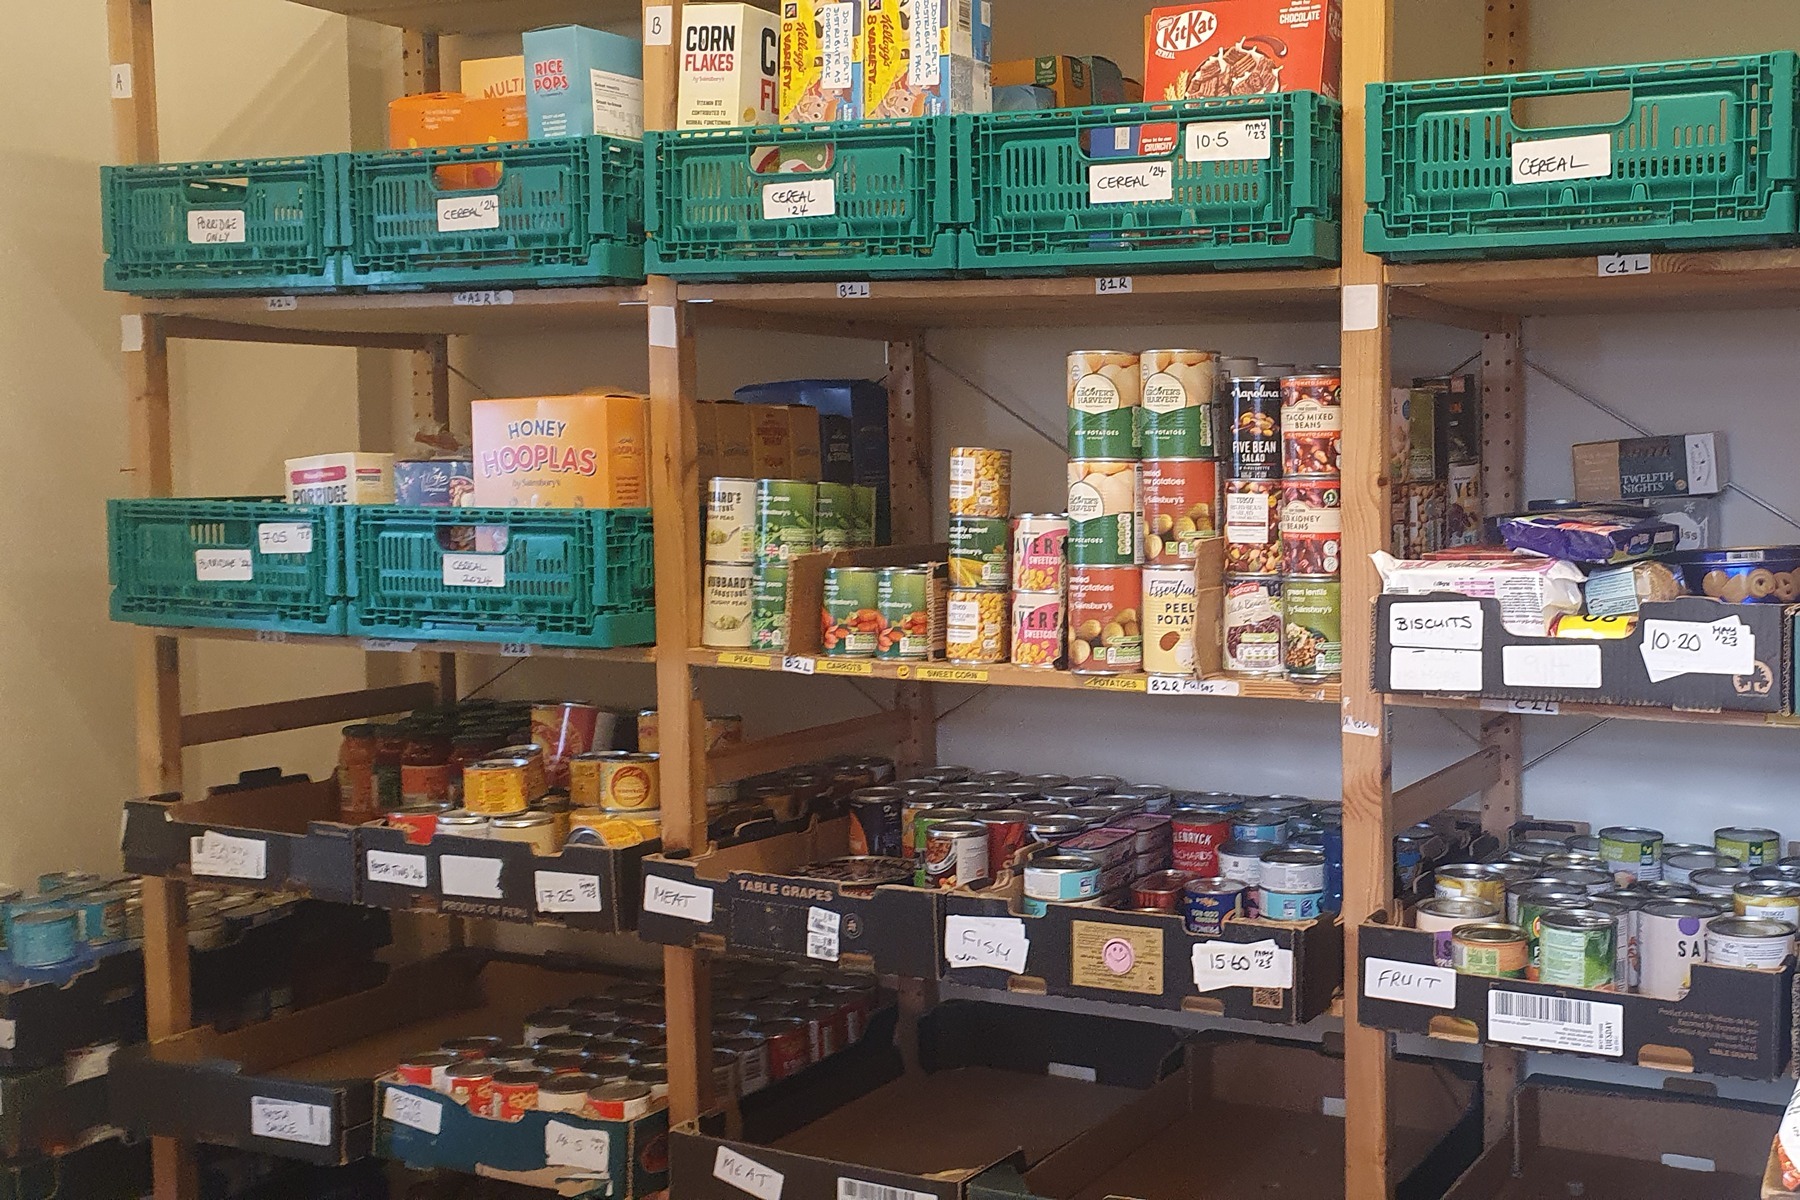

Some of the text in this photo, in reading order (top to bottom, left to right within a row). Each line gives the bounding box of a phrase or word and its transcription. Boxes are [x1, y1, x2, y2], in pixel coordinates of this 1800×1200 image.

[651, 16, 662, 34] B
[1279, 10, 1320, 24] CHOCOLATE
[686, 25, 735, 52] CORN
[1163, 12, 1215, 50] KitKat
[685, 54, 734, 72] FLAKES
[783, 34, 792, 90] VARIETY
[868, 26, 877, 84] VARIETY
[534, 60, 564, 76] RICE
[114, 74, 122, 90] A
[533, 75, 569, 94] POPS
[1144, 142, 1174, 153] CRUNCHY
[1519, 154, 1590, 177] CEREAL
[1097, 174, 1150, 190] CEREAL
[770, 190, 816, 204] CEREAL
[508, 420, 567, 440] HONEY
[1252, 441, 1276, 454] BEAN
[482, 446, 598, 478] HOOPLAS
[1242, 454, 1266, 462] SALAD
[1152, 478, 1186, 487] potatoes
[1622, 472, 1674, 484] TWELFTH
[1622, 482, 1665, 494] NIGHTS
[1148, 496, 1185, 506] Sainsbury's
[1080, 584, 1114, 592] potatoes
[1074, 602, 1114, 612] Sainsbury's
[1165, 603, 1195, 612] PEEL
[1294, 606, 1332, 614] Sainsbury's
[1158, 615, 1195, 625] POTAT
[1394, 616, 1472, 631] BISCUITS
[826, 662, 862, 672] CARROTS
[926, 670, 978, 679] SWEET CORN
[1094, 678, 1137, 688] POTATOES
[652, 886, 696, 908] MEAT
[738, 878, 833, 902] TABLE GRAPES
[442, 900, 528, 919] PRODUCE OF PERU
[961, 928, 1011, 962] FISH
[1378, 970, 1442, 990] FRUIT
[724, 1158, 771, 1188] MEAT
